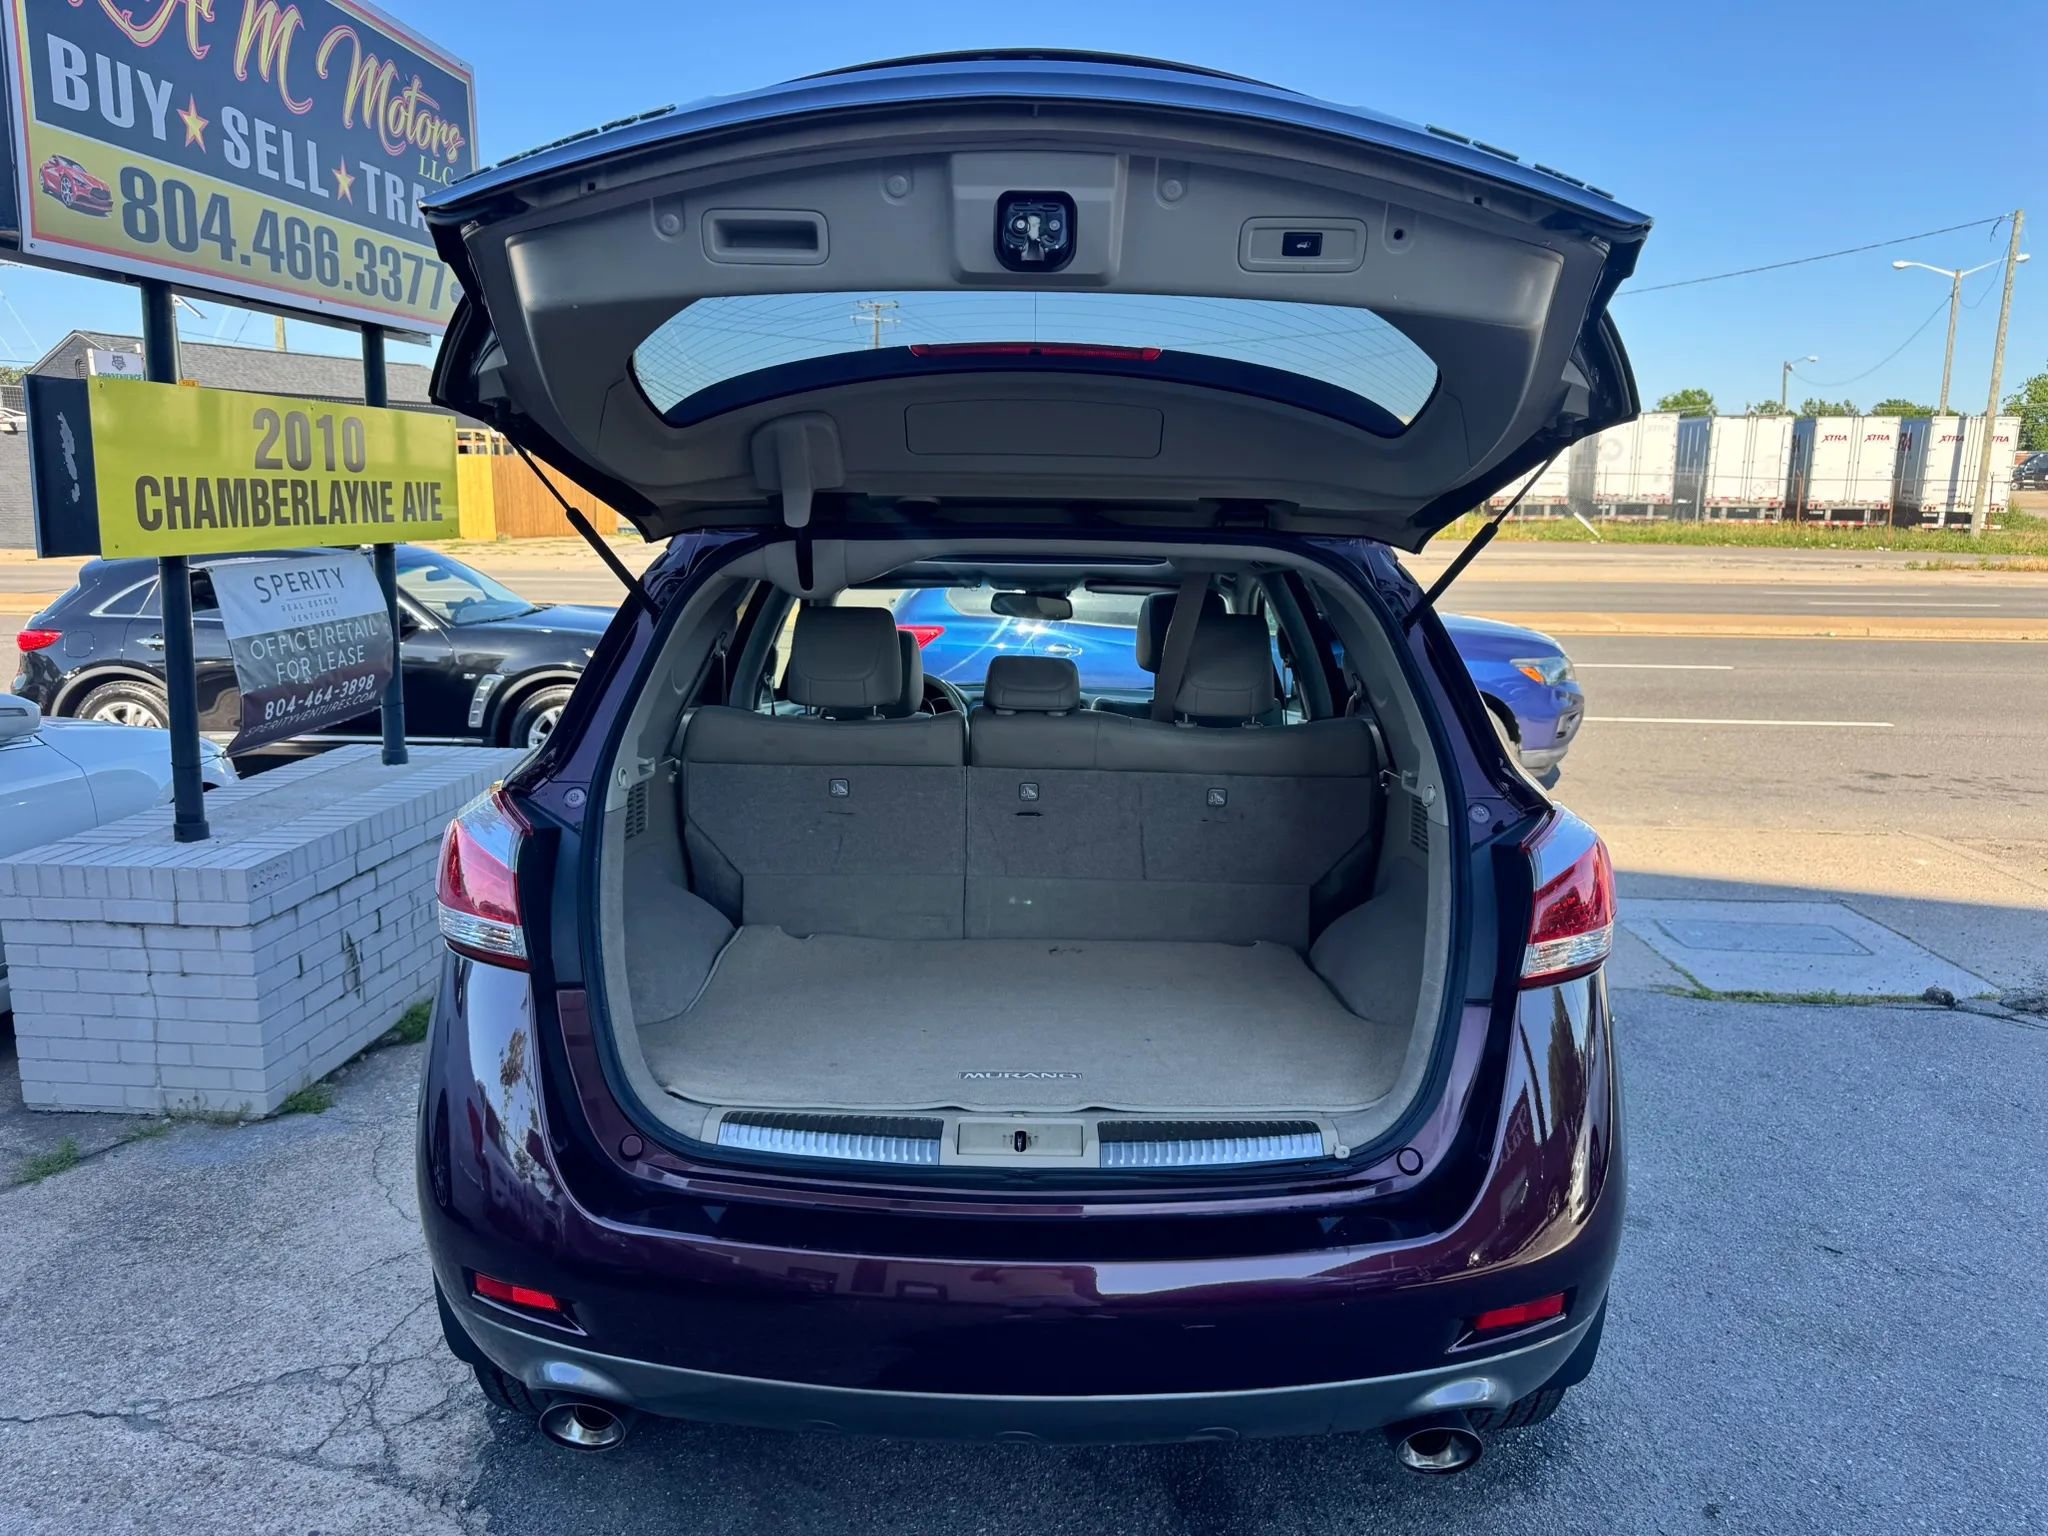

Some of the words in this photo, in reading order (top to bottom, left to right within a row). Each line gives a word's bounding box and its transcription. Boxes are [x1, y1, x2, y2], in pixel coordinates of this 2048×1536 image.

[315, 24, 466, 163] Motors
[46, 32, 174, 142] BUY
[220, 105, 330, 199] SELL
[359, 160, 439, 234] TRA
[119, 166, 448, 311] 804.466.3377
[252, 407, 367, 473] 2010
[1821, 433, 1848, 443] XTRA
[1864, 433, 1890, 443] XTRA
[1938, 434, 1965, 444] XTRA
[1990, 435, 2009, 443] TRA
[135, 475, 395, 531] CHAMBERLAYNE
[402, 481, 443, 523] AVE
[253, 566, 346, 604] SPERITY
[250, 619, 378, 660] OFFICE/RETAIL
[275, 657, 312, 686] FOR
[318, 645, 366, 673] LEASE
[265, 673, 376, 721] 804-464-3898
[962, 1071, 1077, 1080] MURANO
